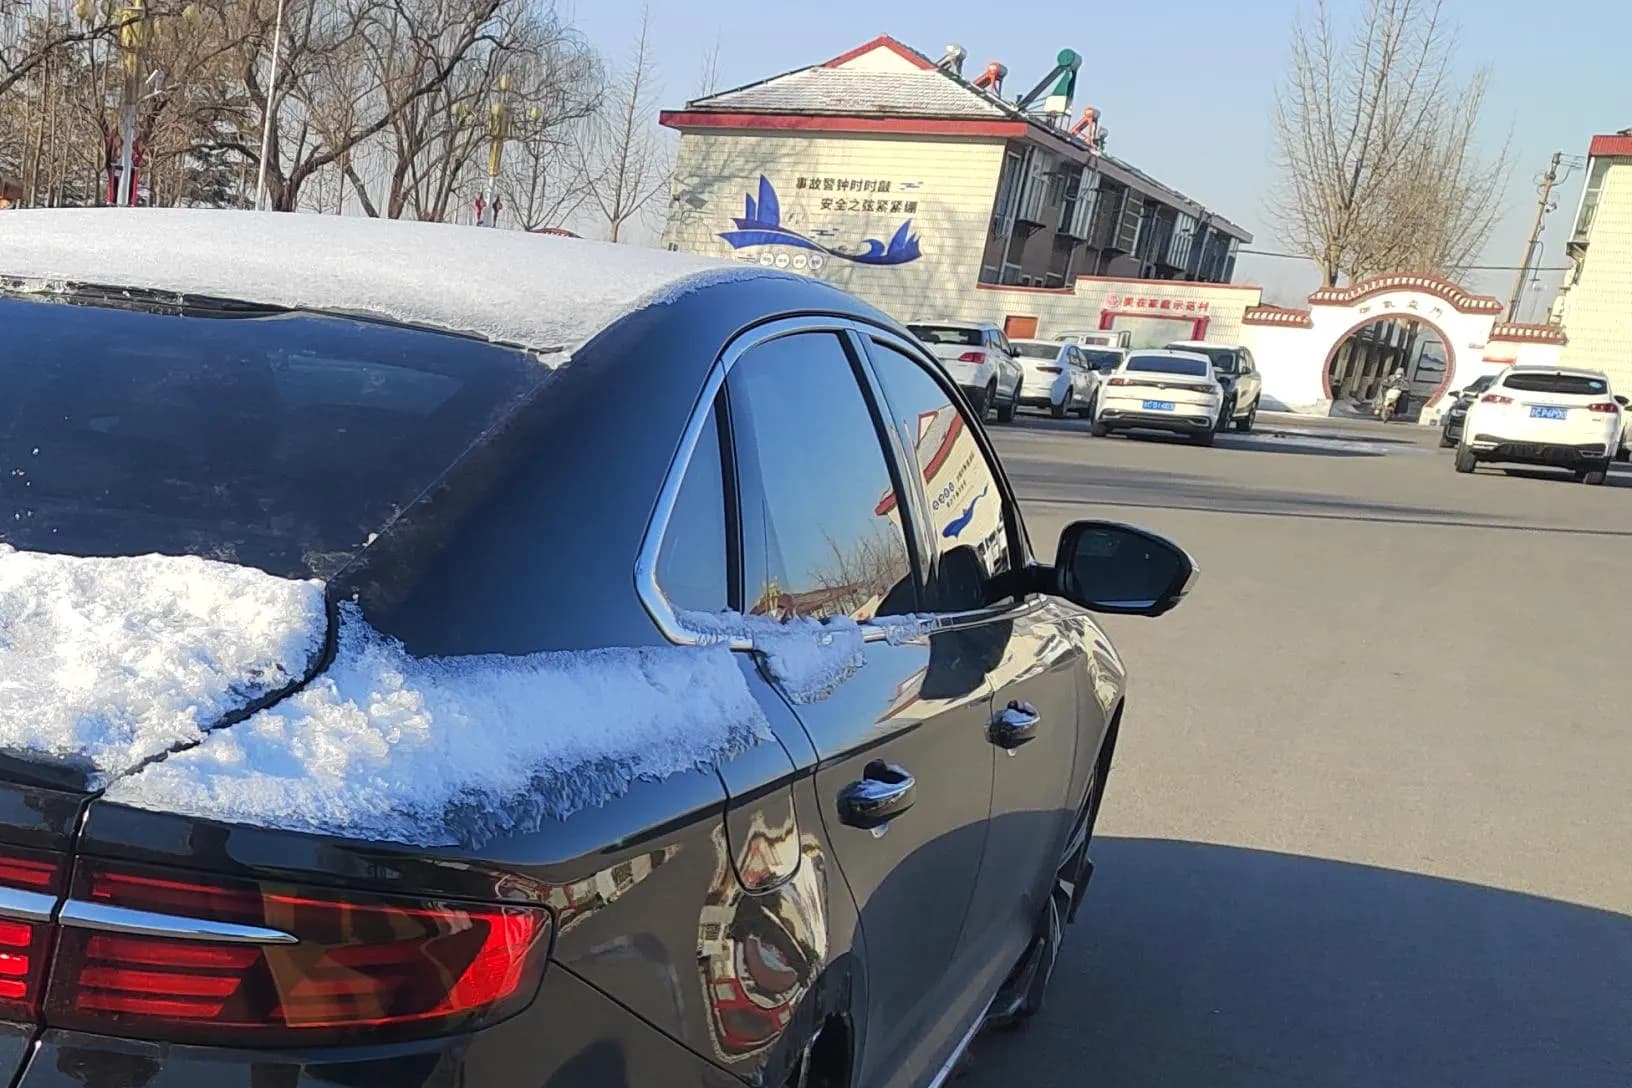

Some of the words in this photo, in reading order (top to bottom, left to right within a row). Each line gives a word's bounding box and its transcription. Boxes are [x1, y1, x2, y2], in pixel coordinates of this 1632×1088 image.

[796, 177, 891, 193] 事故警钟时时敲
[820, 198, 918, 214] 安全之弦紧紧绷
